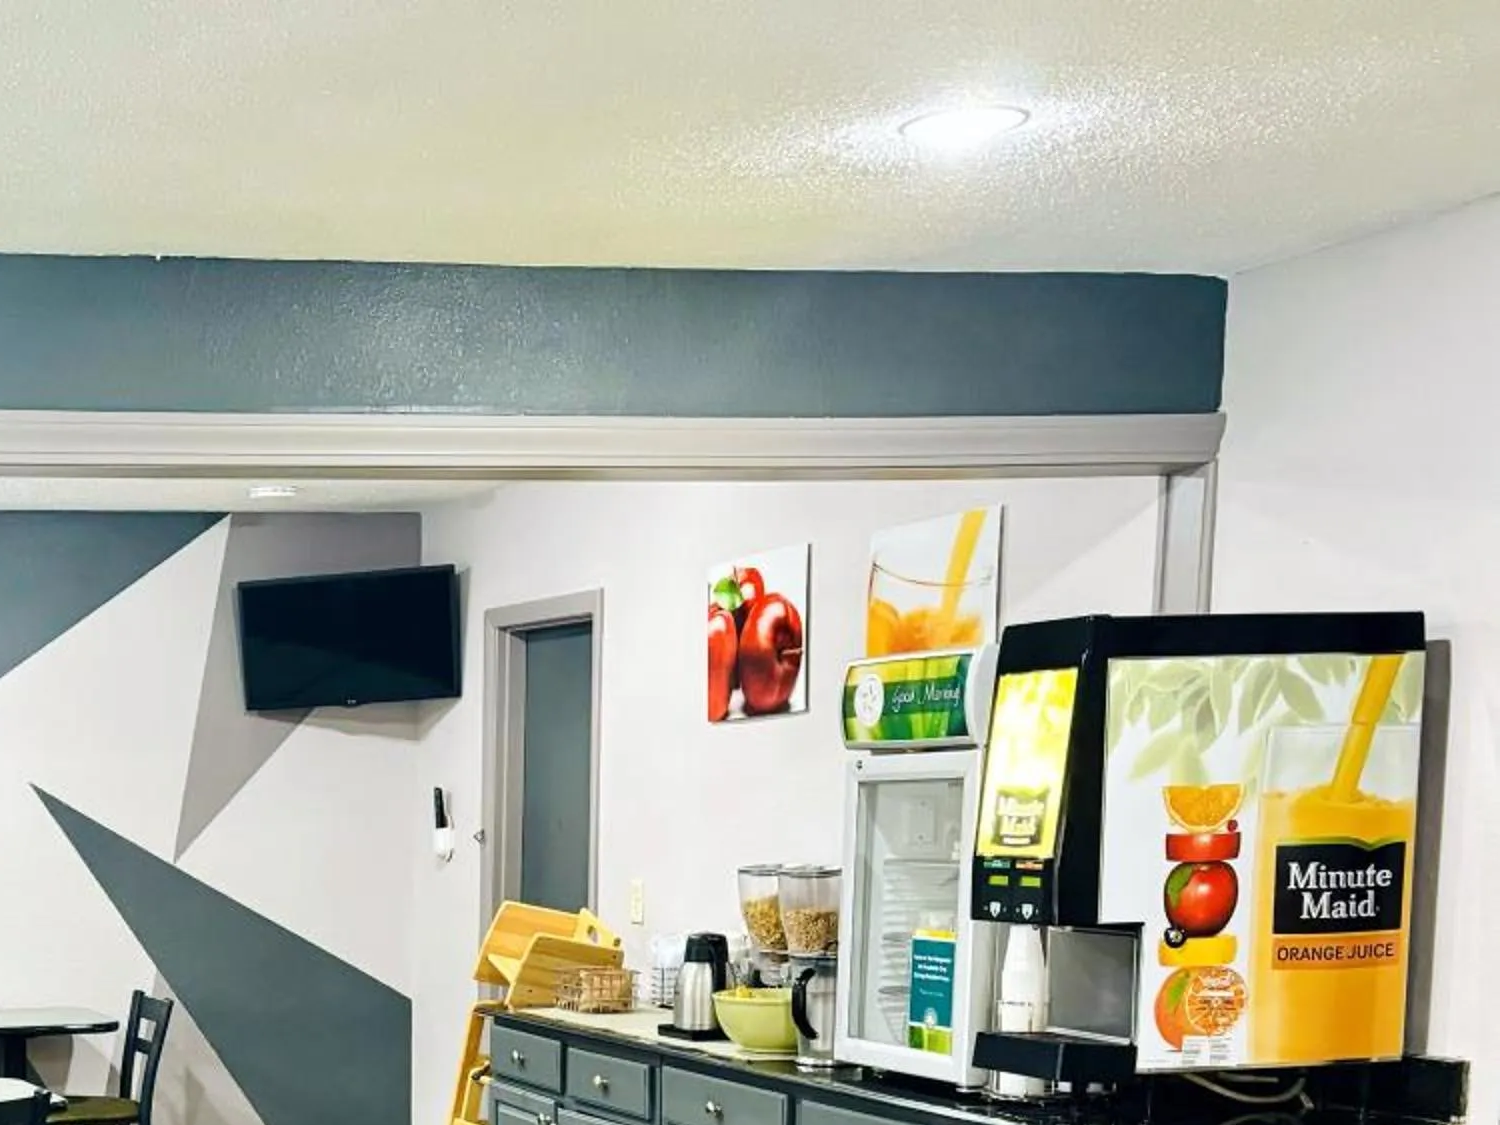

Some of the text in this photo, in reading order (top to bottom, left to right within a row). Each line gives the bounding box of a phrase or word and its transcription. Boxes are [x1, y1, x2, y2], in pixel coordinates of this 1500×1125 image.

[1287, 861, 1393, 889] Minute
[1300, 889, 1377, 919] Maid
[1277, 942, 1395, 961] ORANGE JUICE
